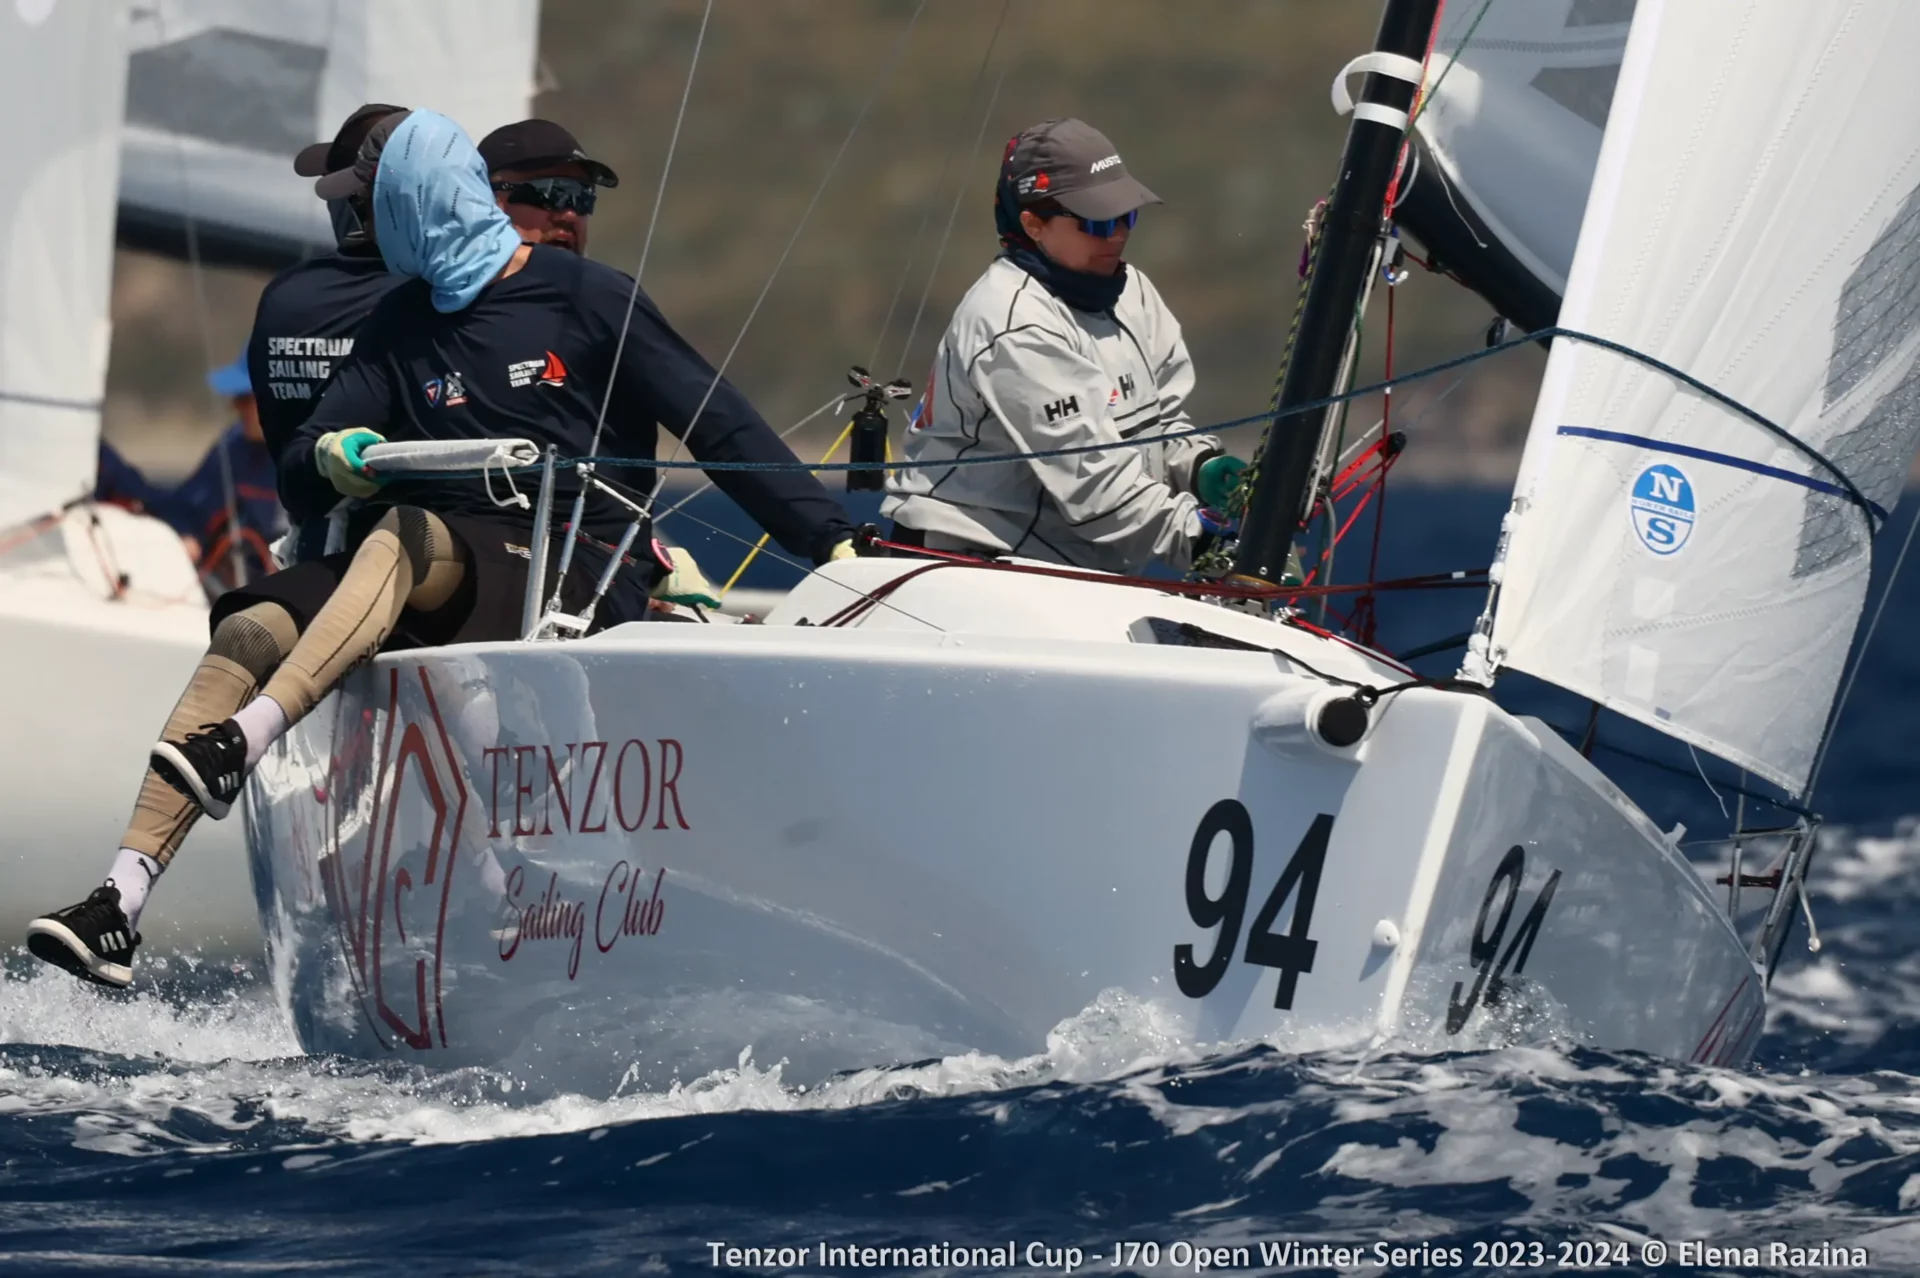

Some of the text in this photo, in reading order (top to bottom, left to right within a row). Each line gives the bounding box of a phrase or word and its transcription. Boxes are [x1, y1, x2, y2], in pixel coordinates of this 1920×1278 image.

[268, 360, 331, 379] SAILING
[1044, 395, 1080, 422] HH
[1648, 471, 1685, 503] N
[1646, 516, 1677, 546] S
[481, 738, 691, 838] TENZOR
[499, 859, 666, 981] Sailing Club
[1173, 798, 1335, 1011] 94
